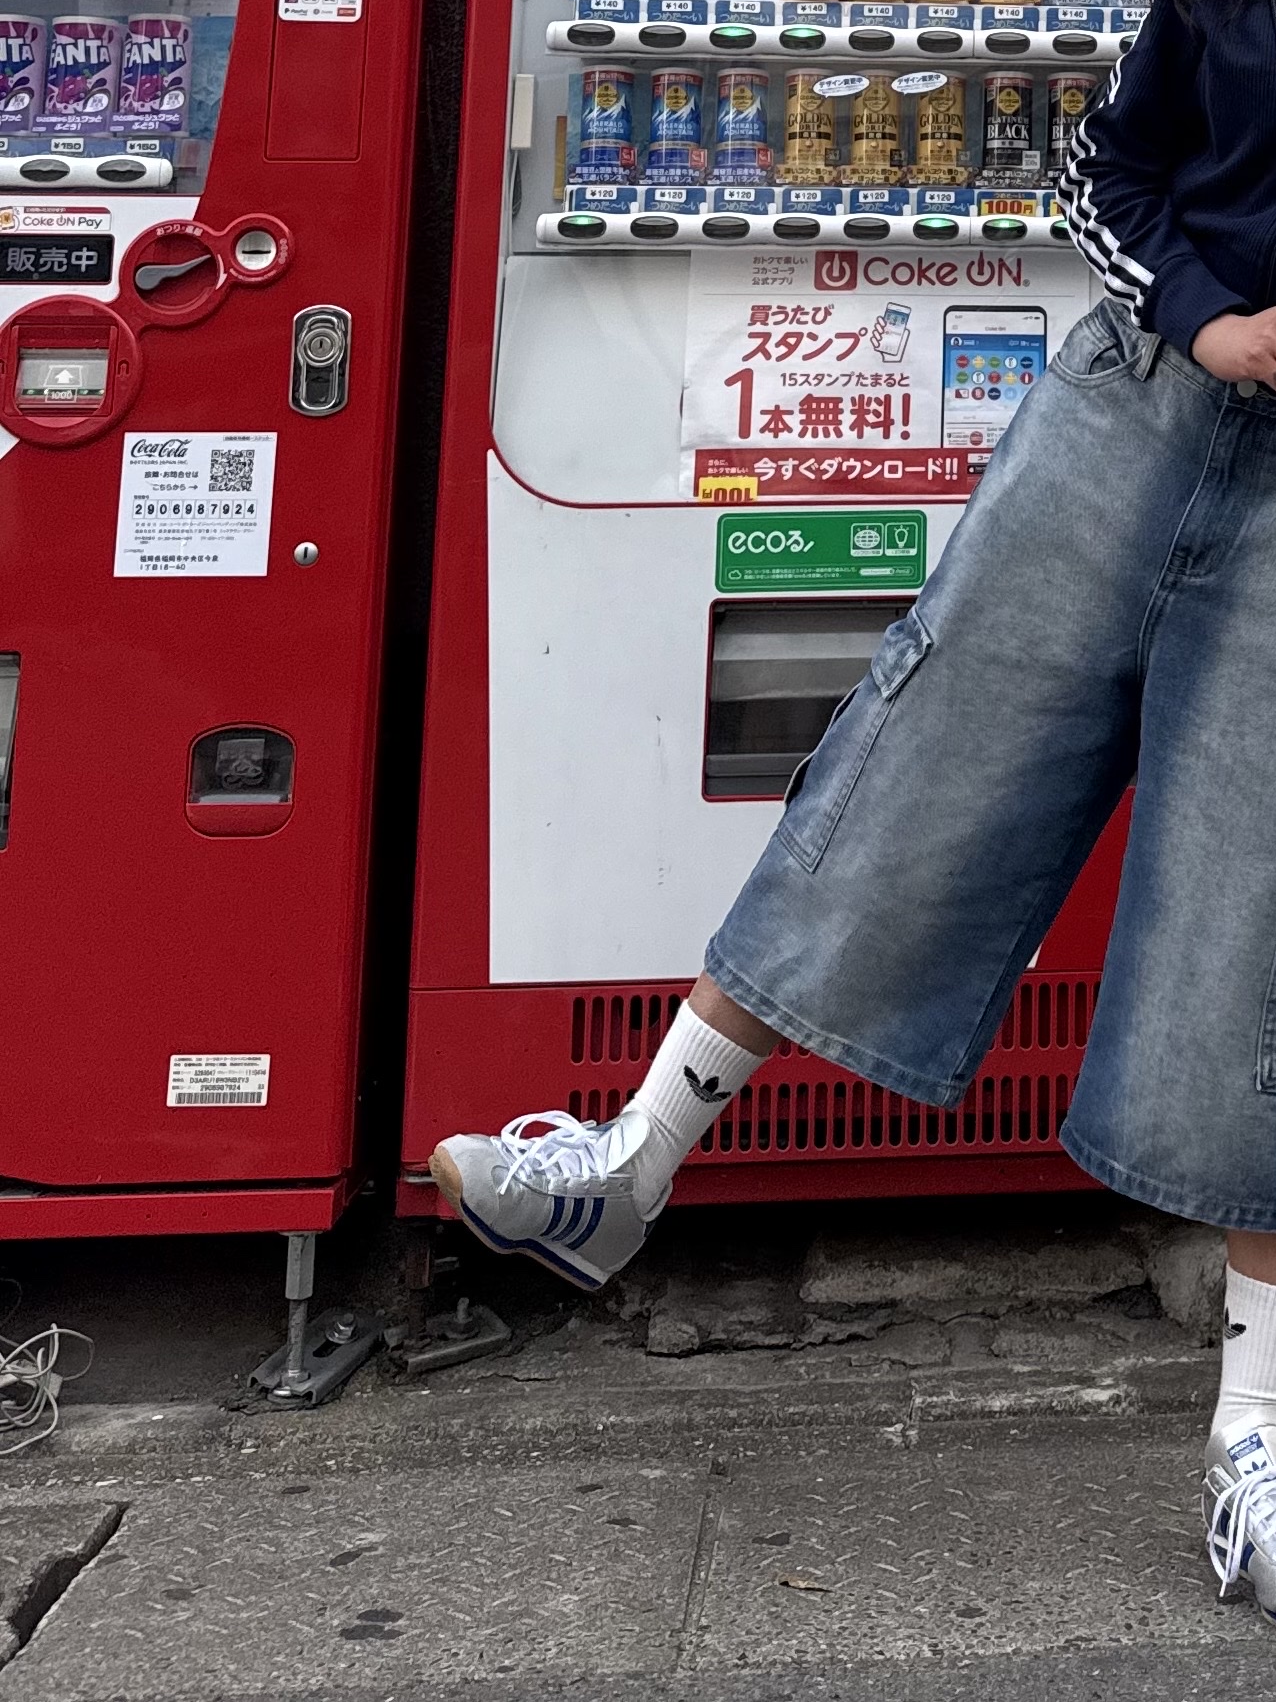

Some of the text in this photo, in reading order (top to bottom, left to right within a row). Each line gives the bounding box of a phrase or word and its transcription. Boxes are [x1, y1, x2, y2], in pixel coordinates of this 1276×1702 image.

[595, 1, 618, 9] ¥140
[665, 2, 689, 10] ¥140
[733, 3, 756, 11] ¥140
[801, 4, 823, 12] ¥140
[867, 6, 890, 15] ¥140
[933, 7, 955, 16] ¥140
[998, 8, 1020, 16] ¥140
[1062, 10, 1084, 19] ¥140
[124, 39, 186, 70] FANTA
[589, 120, 623, 128] EMERALD
[788, 113, 832, 127] GOLDEN
[854, 113, 898, 127] GOLDEN
[920, 113, 963, 127] GOLDEN
[987, 125, 1029, 140] BLACK
[1052, 125, 1078, 140] BLA
[54, 142, 81, 150] ¥150
[129, 143, 158, 151] ¥150
[590, 189, 613, 198] ¥120
[660, 191, 683, 199] ¥120
[728, 190, 751, 199] ¥120
[794, 191, 818, 201] ¥120
[862, 191, 885, 201] ¥120
[928, 192, 951, 202] ¥120
[985, 200, 1033, 214] 100円
[23, 215, 103, 229] Coke ON Pay
[6, 246, 98, 273] 販売中
[752, 256, 808, 266] おトクで楽しい
[752, 266, 795, 275] コカ・コーラ
[863, 250, 1022, 287] Coke ON
[752, 276, 793, 286] 公式アプリ
[747, 303, 835, 327] 買うたび
[741, 326, 869, 363] スタンプ
[780, 372, 911, 388] 15スタンプたまると
[130, 439, 193, 458] Coca-Cola
